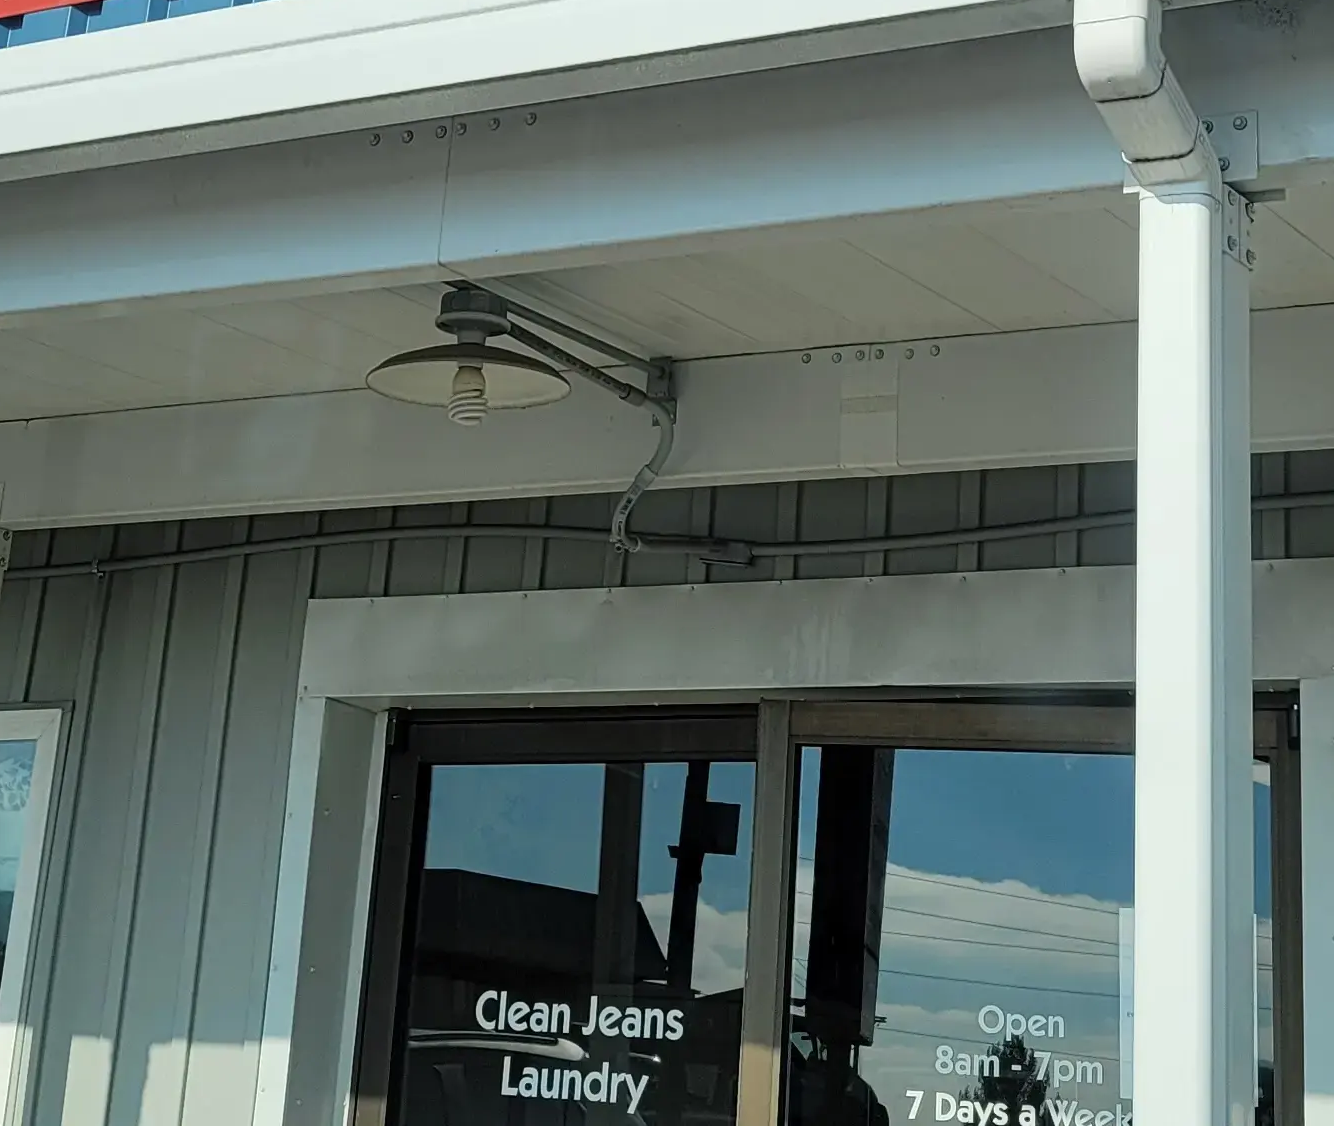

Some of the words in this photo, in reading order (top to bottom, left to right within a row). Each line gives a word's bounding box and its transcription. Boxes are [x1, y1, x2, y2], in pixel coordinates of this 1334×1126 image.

[475, 989, 571, 1034] Clean
[581, 995, 685, 1041] Jeans
[977, 1004, 1066, 1042] Open
[500, 1055, 650, 1115] Laundry
[934, 1045, 1001, 1078] 8am
[1032, 1051, 1104, 1088] 7pm
[905, 1089, 925, 1121] 7
[935, 1091, 1009, 1126] Days
[1018, 1104, 1036, 1126] a
[1045, 1097, 1133, 1126] Week
